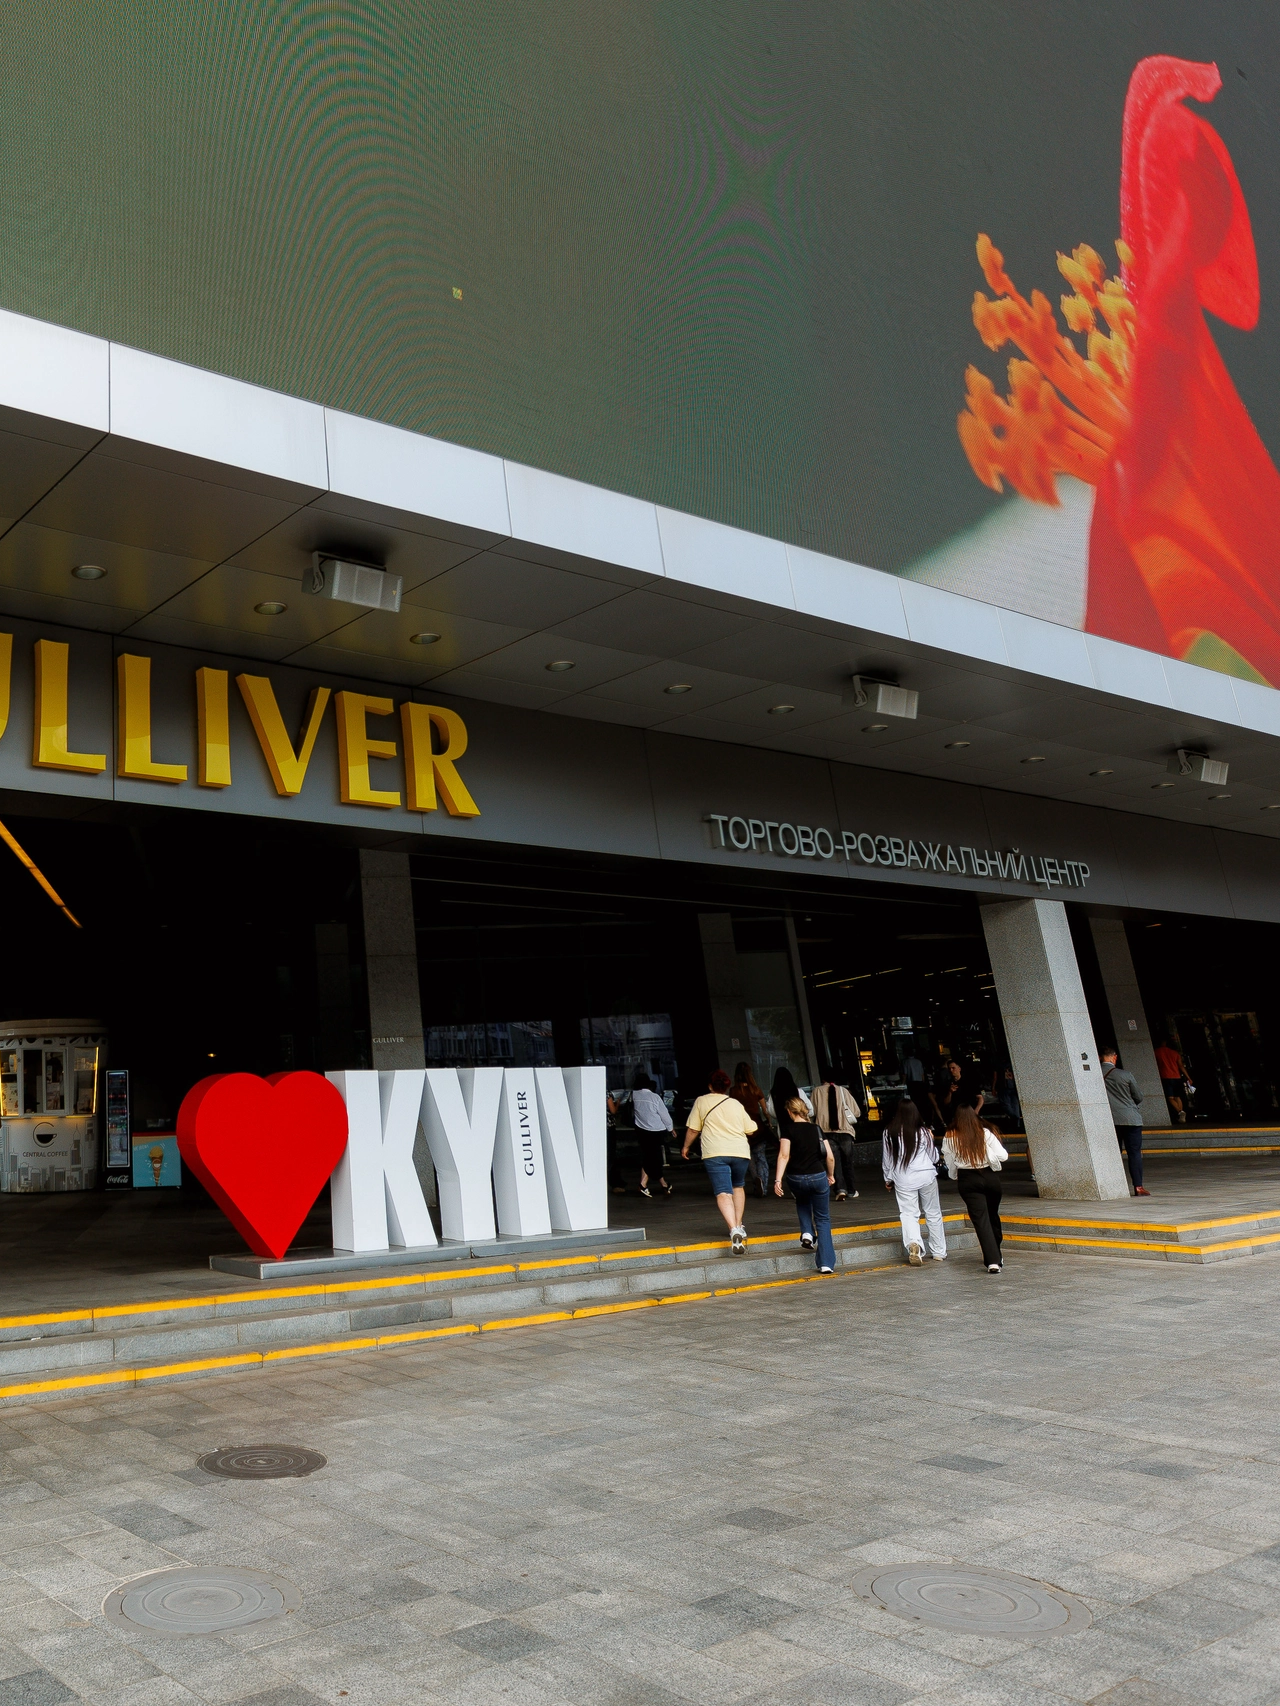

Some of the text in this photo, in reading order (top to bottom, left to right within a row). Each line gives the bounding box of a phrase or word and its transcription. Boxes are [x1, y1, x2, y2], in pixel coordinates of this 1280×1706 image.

[706, 814, 1091, 890] ТОРГОВО-РОЗВАЖАЛЬНИЙ ЦЕНТР
[372, 1036, 405, 1044] GULLIVER
[325, 1066, 608, 1252] KYIV
[516, 1090, 534, 1177] GULLIVER
